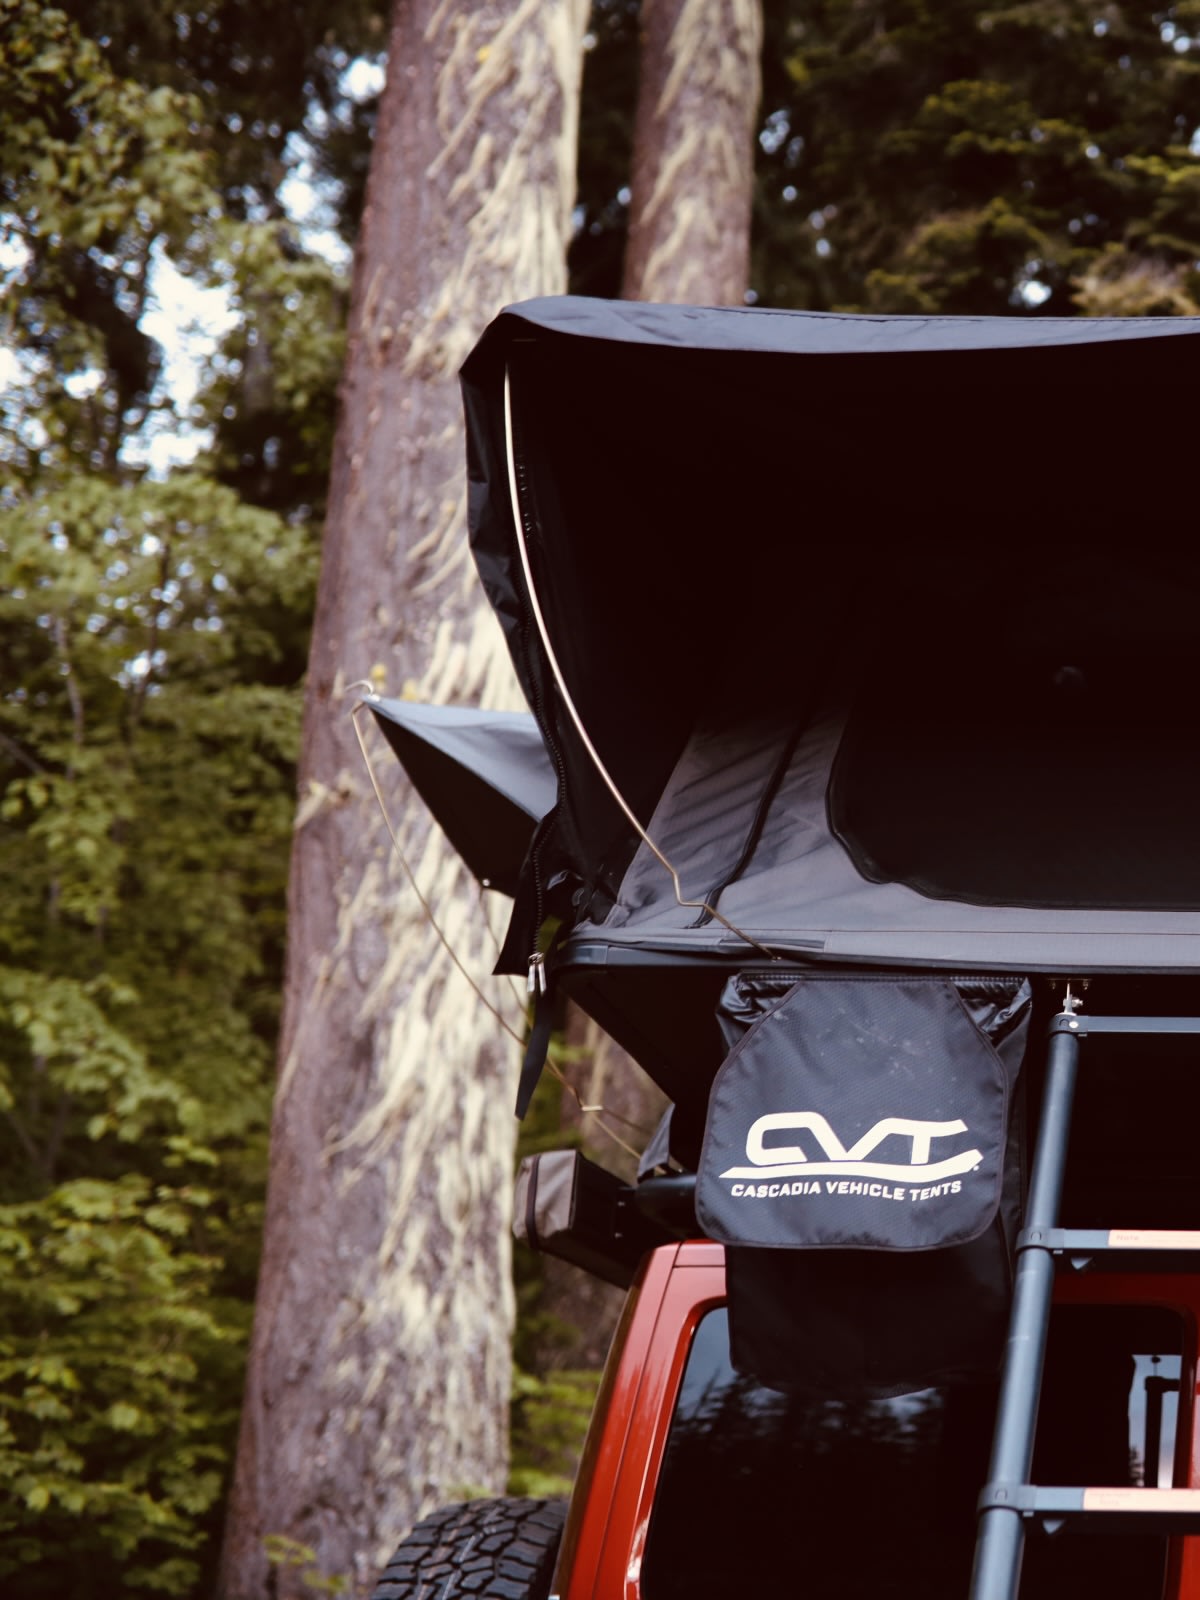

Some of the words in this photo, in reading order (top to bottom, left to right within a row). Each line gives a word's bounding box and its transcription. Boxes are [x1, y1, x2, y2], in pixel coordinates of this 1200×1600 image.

[745, 1111, 969, 1166] CVT
[730, 1181, 821, 1198] CASCADIA
[825, 1181, 906, 1201] VEHICLE
[909, 1180, 962, 1202] TENTS
